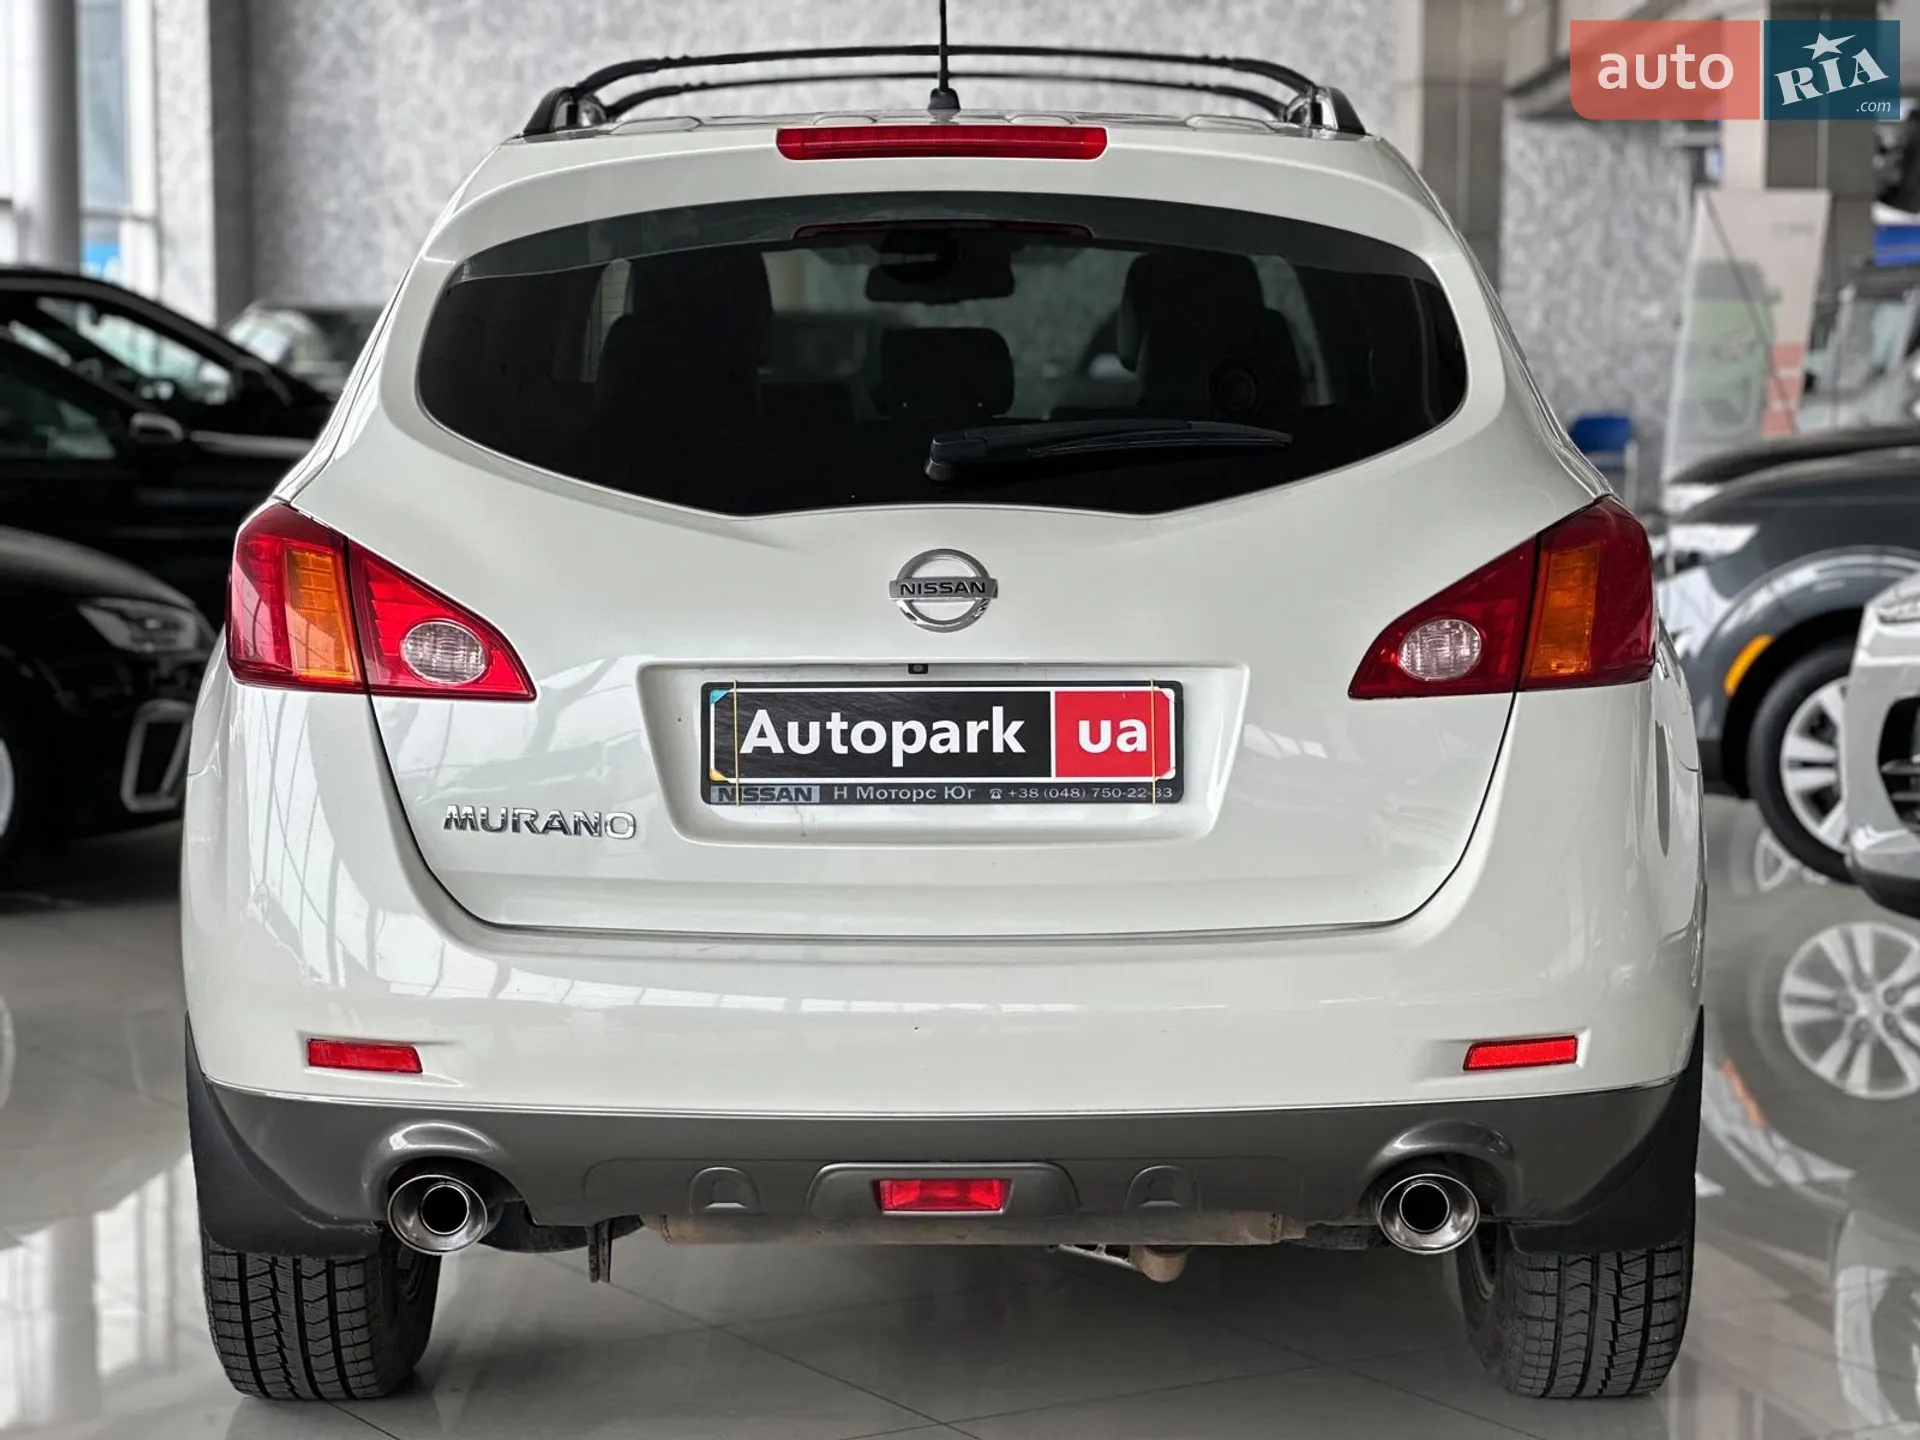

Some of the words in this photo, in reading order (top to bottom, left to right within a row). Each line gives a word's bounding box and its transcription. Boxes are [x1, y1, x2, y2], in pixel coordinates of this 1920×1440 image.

[900, 581, 986, 595] NISSAN
[740, 706, 1026, 768] Autopark
[1078, 718, 1148, 753] ua
[717, 787, 813, 802] NISSAN
[856, 786, 937, 804] Моторс
[944, 785, 976, 800] Юг
[1008, 788, 1039, 799] +38
[1043, 787, 1086, 799] (048)
[443, 804, 637, 840] MURANO
